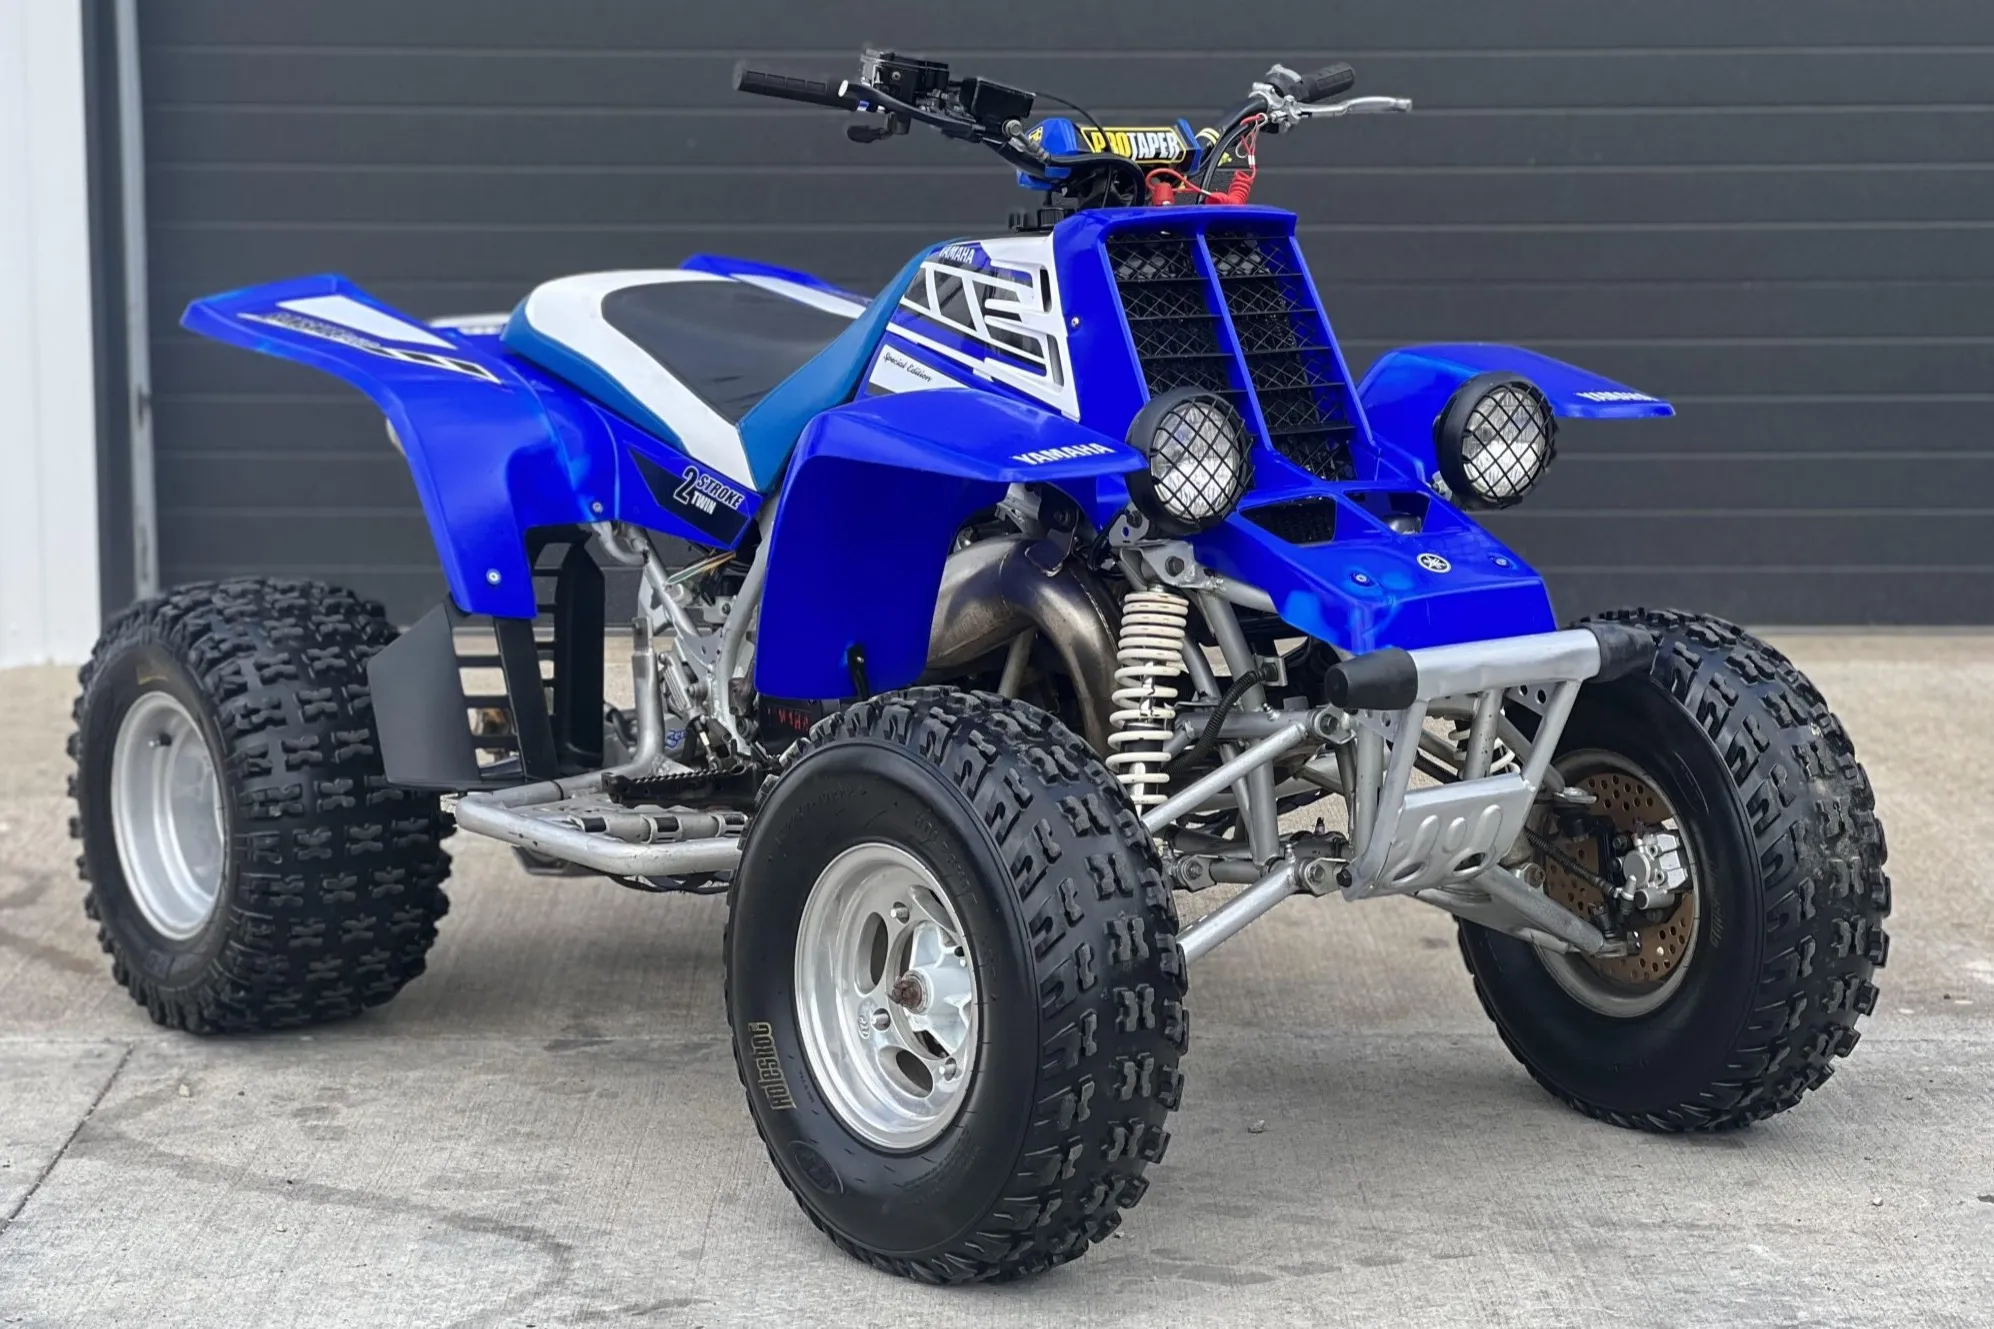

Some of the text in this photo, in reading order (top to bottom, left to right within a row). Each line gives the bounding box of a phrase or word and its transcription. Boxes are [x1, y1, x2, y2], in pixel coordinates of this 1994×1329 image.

[939, 244, 975, 265] YAMAHA
[884, 352, 932, 382] Special Edition
[1011, 442, 1115, 465] YAMAHA
[673, 465, 745, 511] 2 STROKE
[691, 490, 717, 515] TWIN
